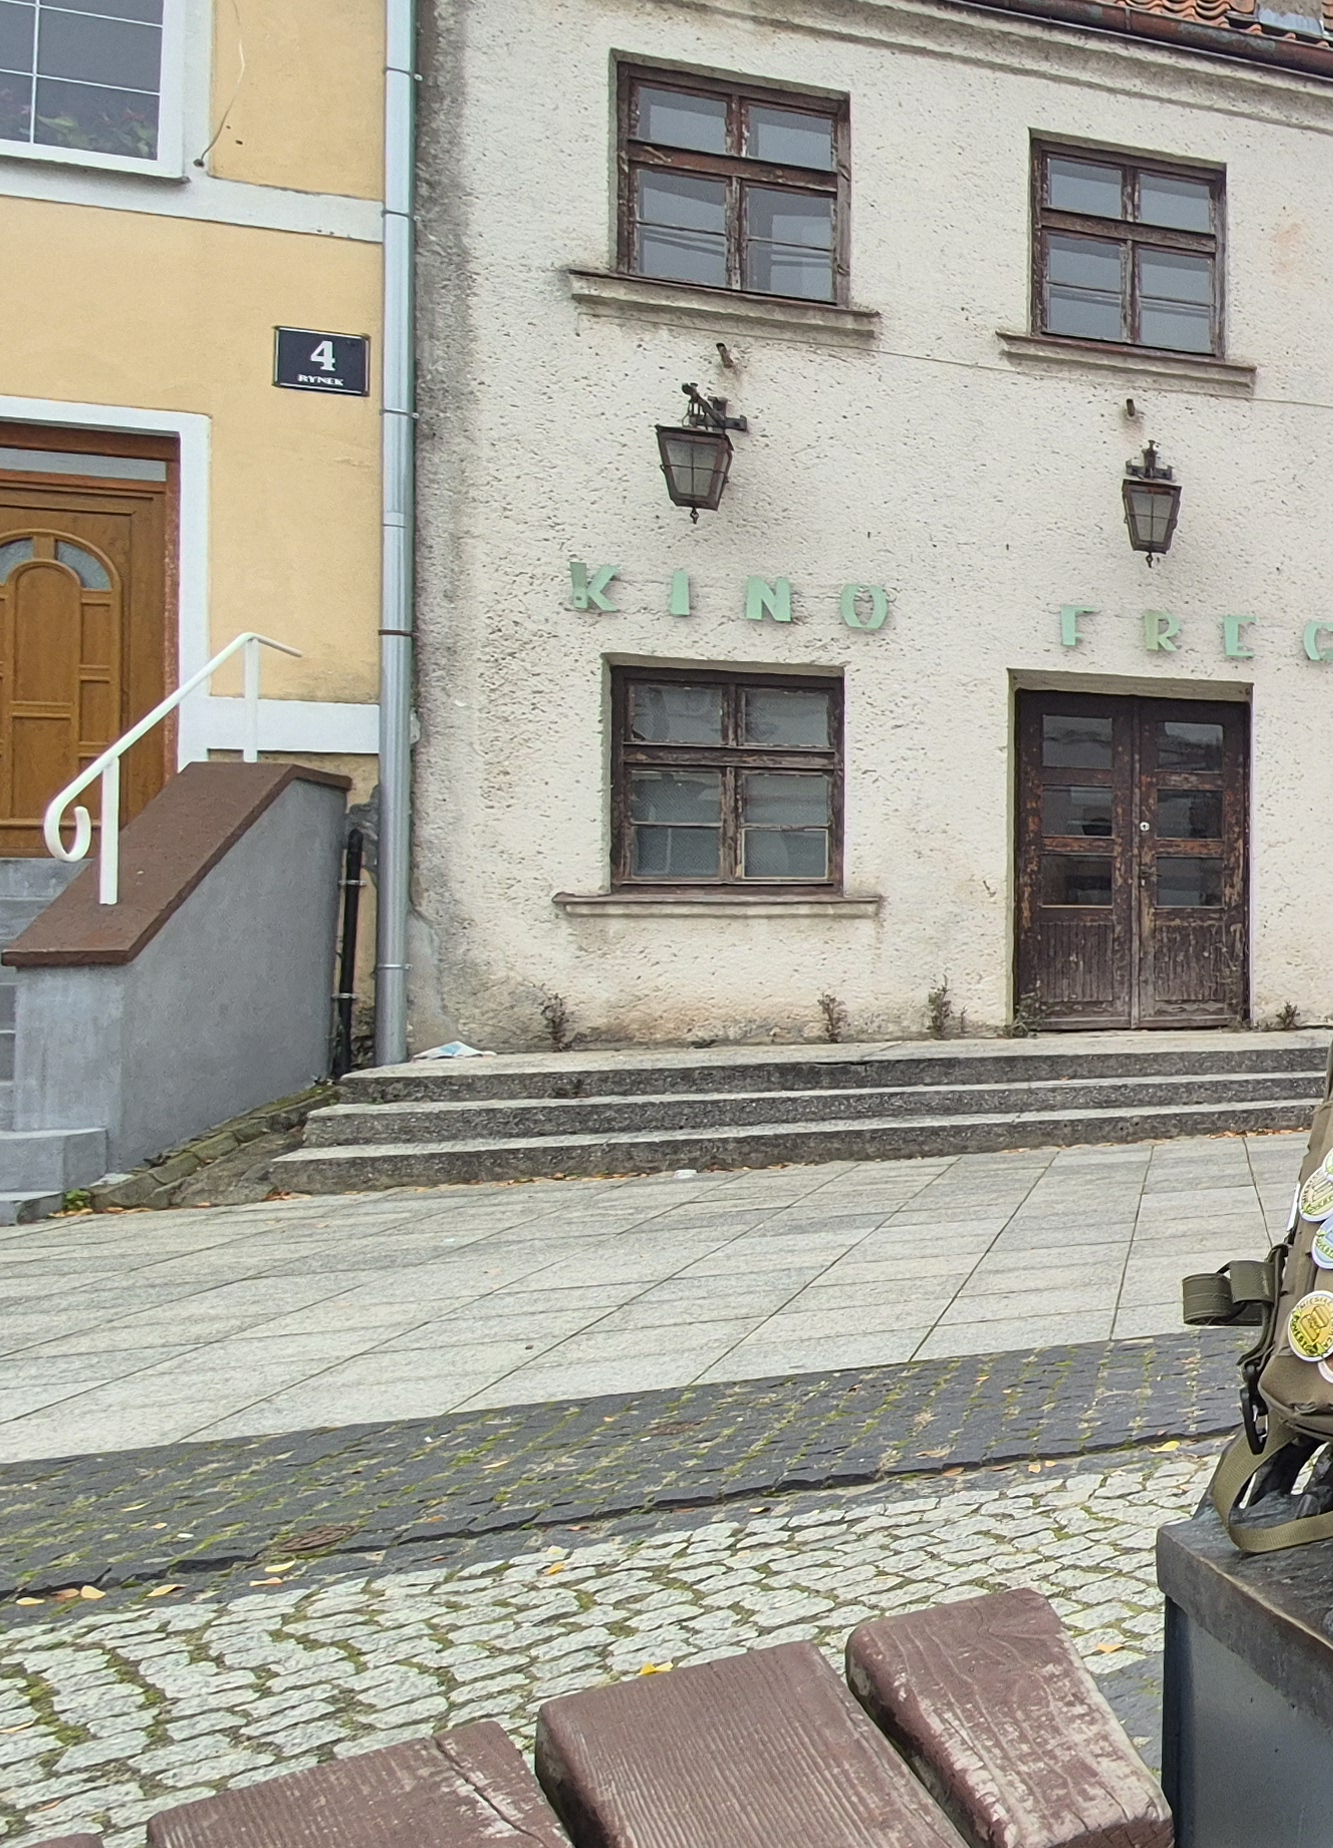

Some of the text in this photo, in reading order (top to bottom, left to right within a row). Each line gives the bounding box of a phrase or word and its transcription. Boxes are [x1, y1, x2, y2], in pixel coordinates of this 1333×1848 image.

[310, 340, 336, 371] 4
[297, 373, 344, 386] RYNEK
[569, 561, 889, 629] KINO
